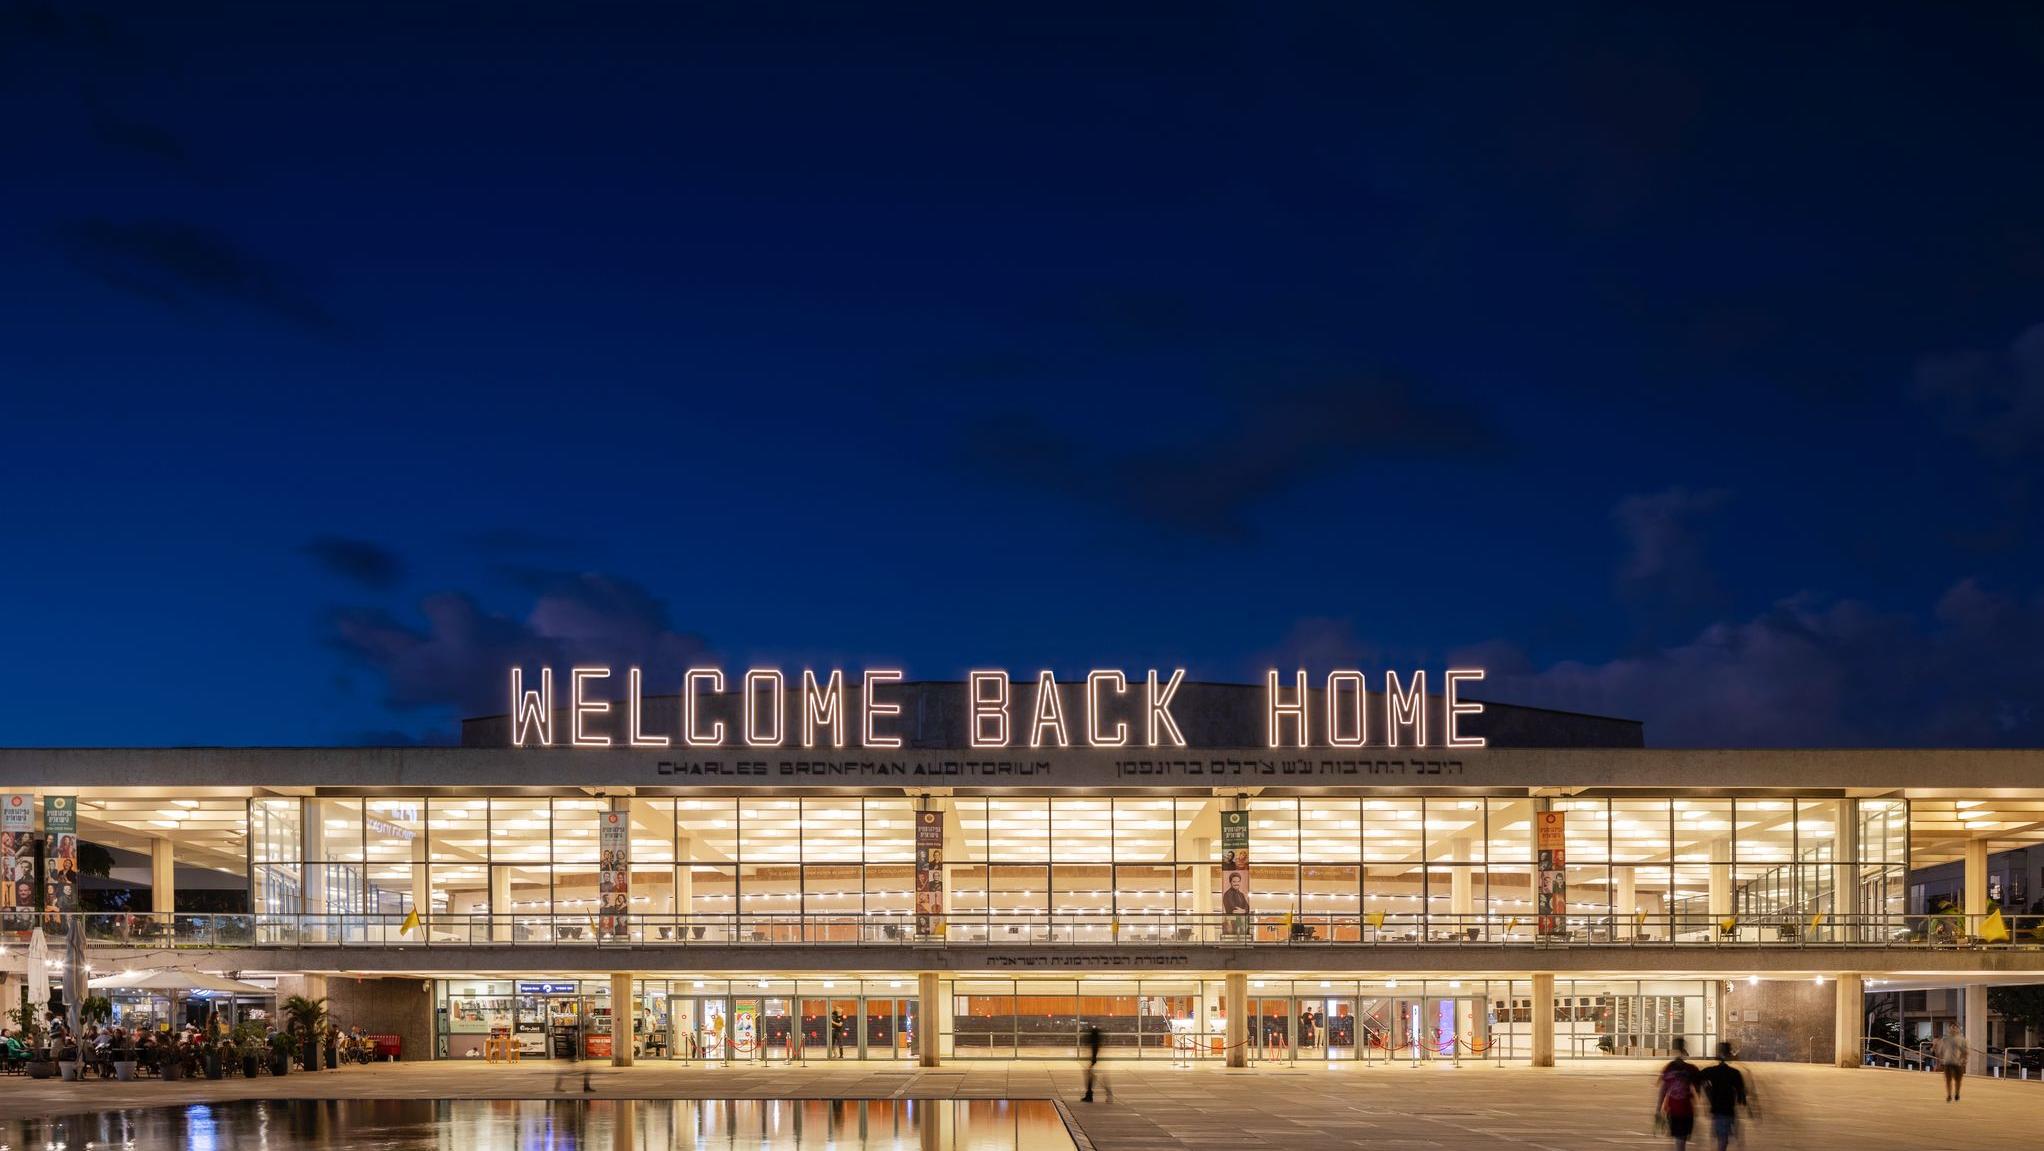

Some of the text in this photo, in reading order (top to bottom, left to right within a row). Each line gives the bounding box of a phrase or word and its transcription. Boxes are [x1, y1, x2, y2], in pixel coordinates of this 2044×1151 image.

[512, 668, 1487, 748] WELCOME BACK HOME
[657, 761, 1051, 776] CHARLES BRONFMAN AUDITORIUM
[1115, 760, 1204, 778] ברונפמן
[1319, 760, 1405, 775] התרבות
[1410, 759, 1463, 775] היכל
[986, 956, 1048, 966] הישראלית
